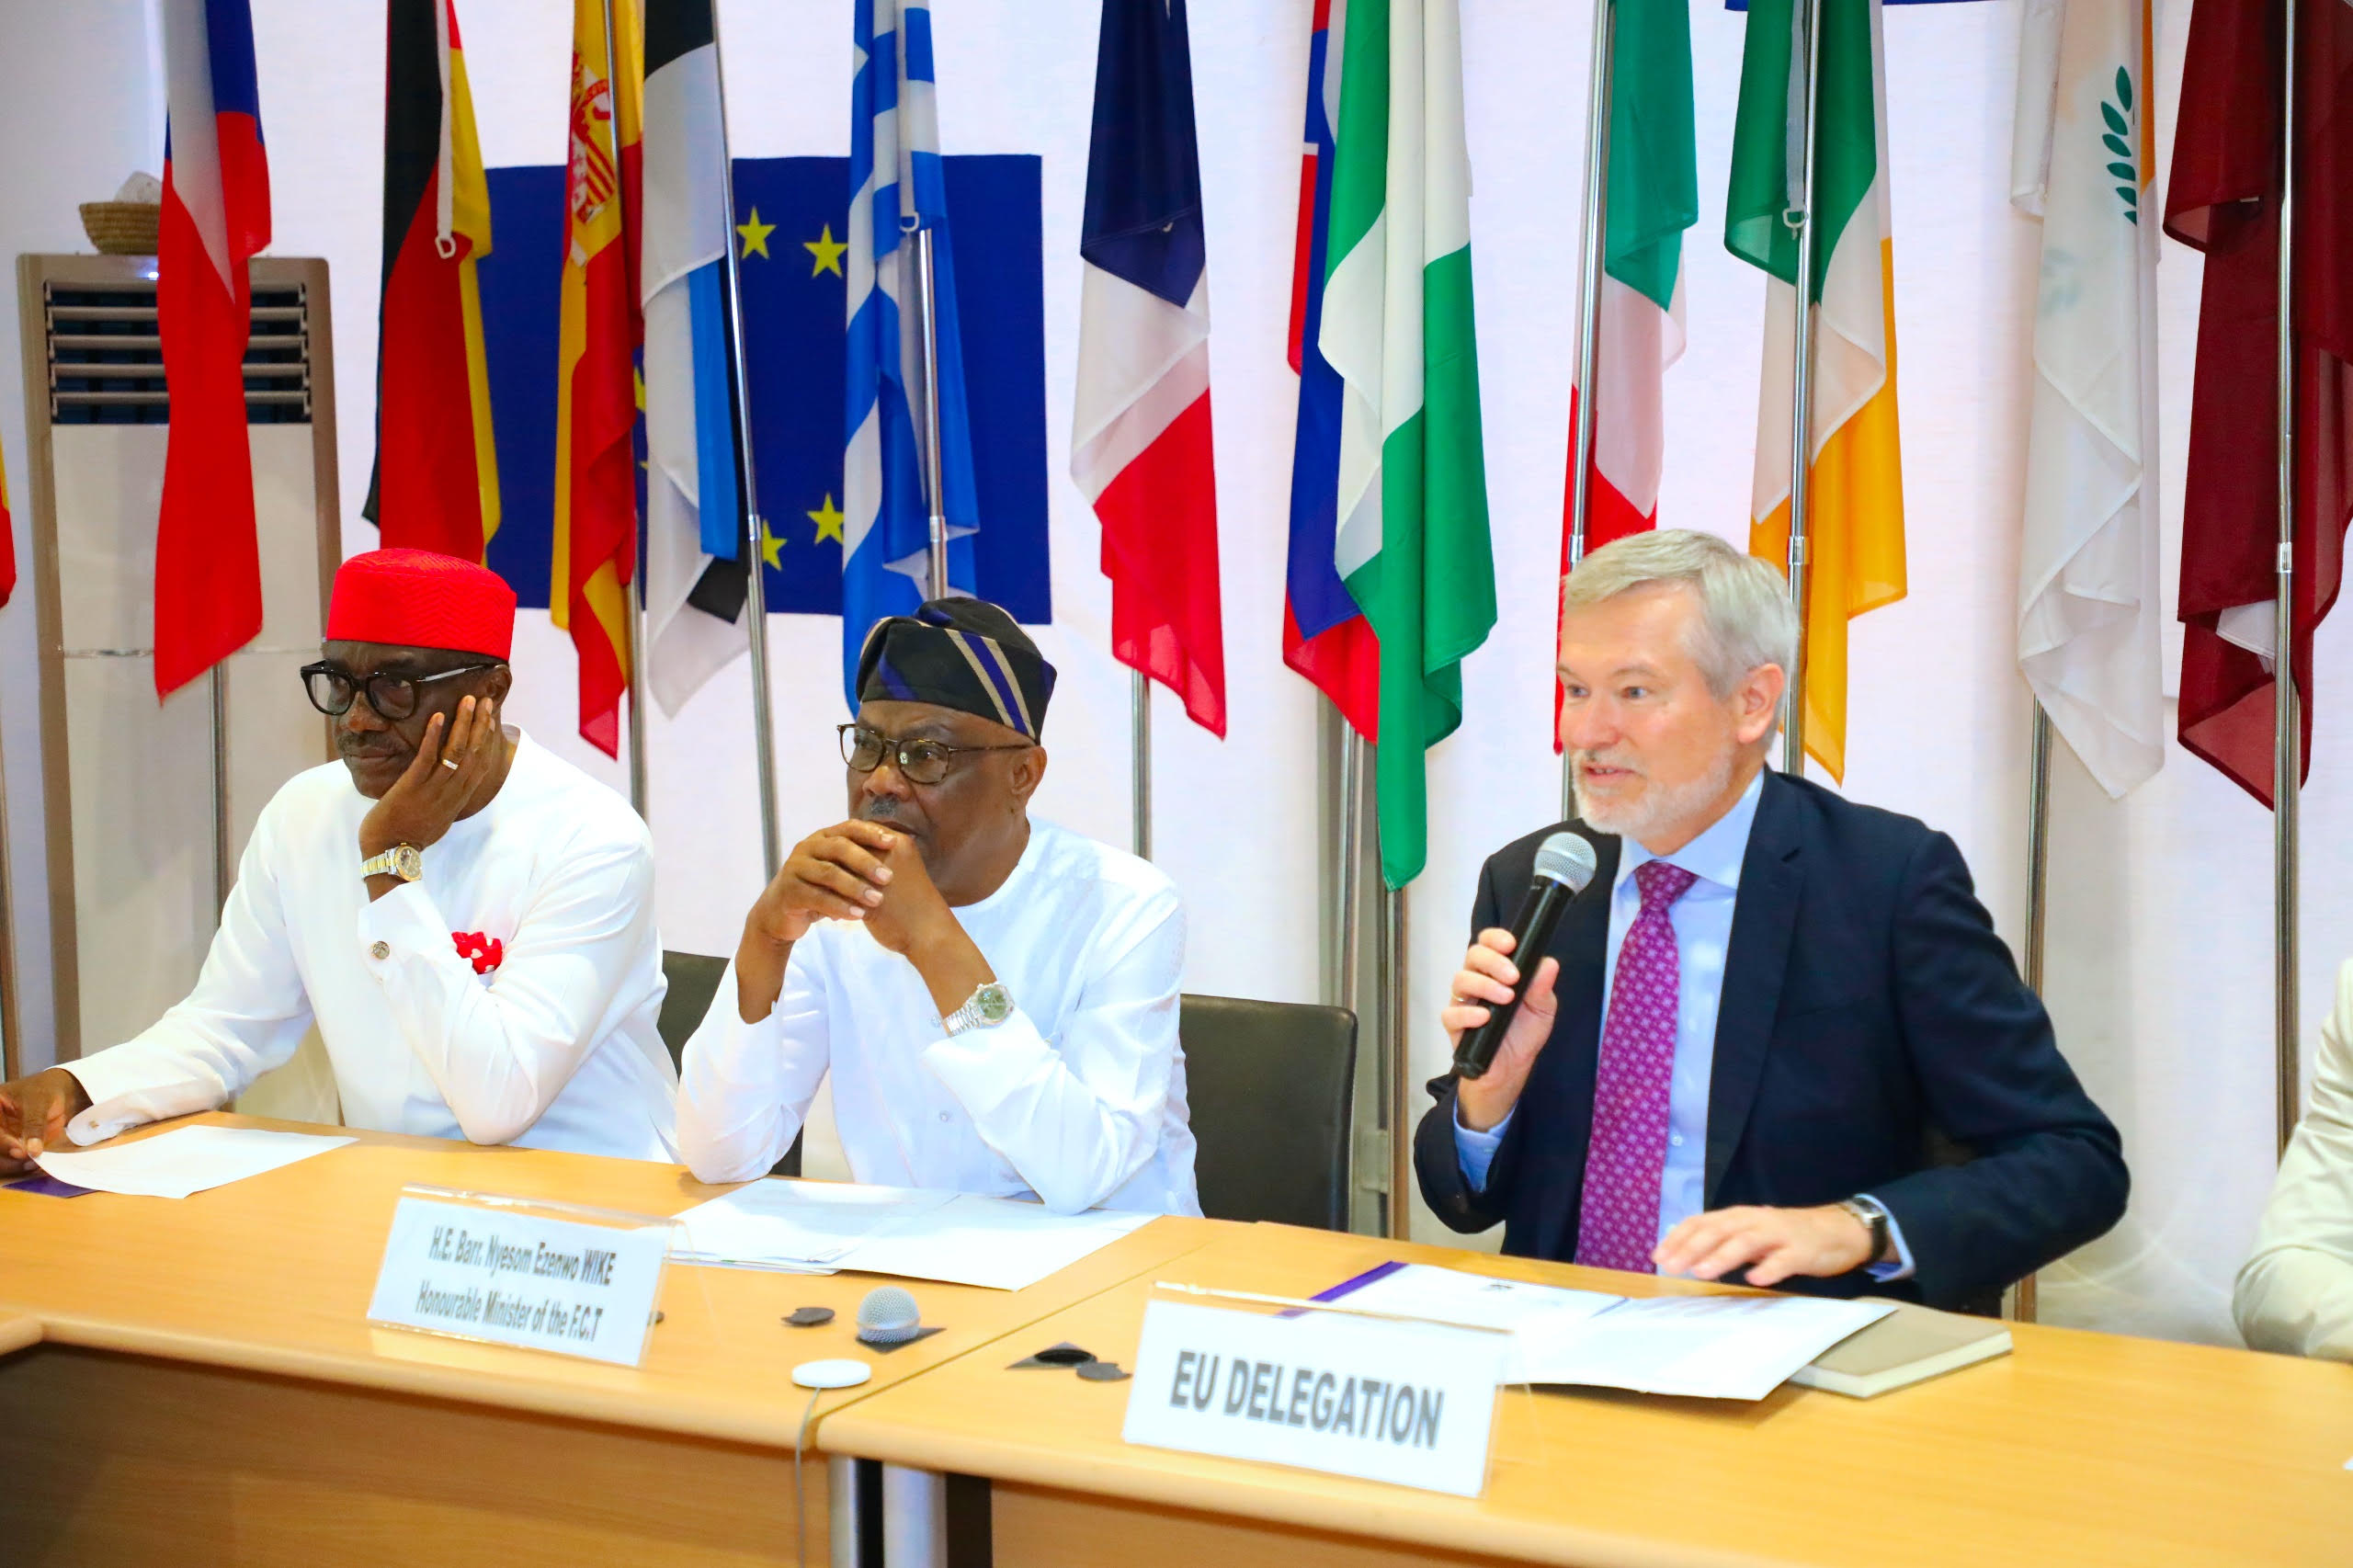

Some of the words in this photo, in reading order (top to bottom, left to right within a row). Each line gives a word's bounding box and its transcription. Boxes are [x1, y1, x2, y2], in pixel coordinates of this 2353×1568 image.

[428, 1226, 454, 1260] H.E.
[485, 1234, 532, 1278] Nyesom
[533, 1242, 579, 1281] Ezenwo
[580, 1249, 617, 1286] WIKE
[415, 1279, 483, 1322] Honourable
[483, 1290, 532, 1331] Minister
[531, 1300, 550, 1332] of
[547, 1301, 568, 1336] the
[1169, 1350, 1220, 1412] EU
[1225, 1358, 1444, 1448] DELEGATION
